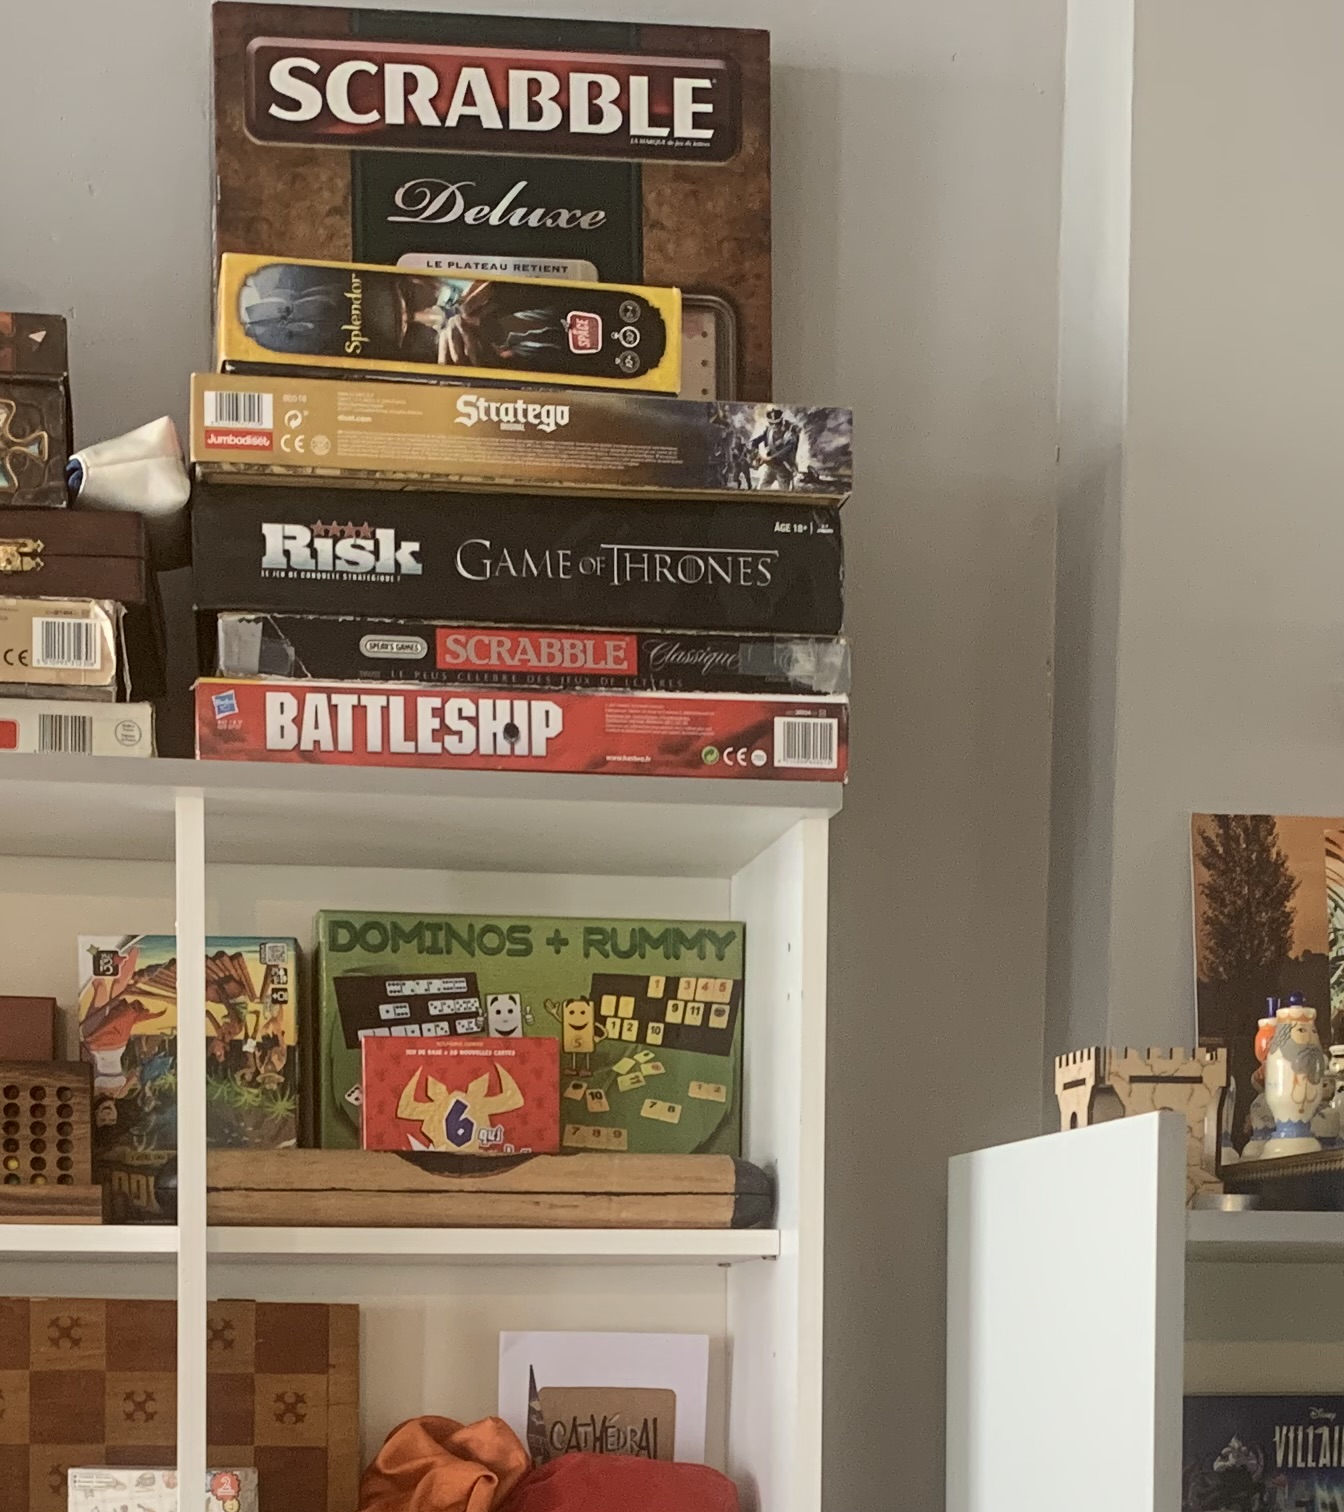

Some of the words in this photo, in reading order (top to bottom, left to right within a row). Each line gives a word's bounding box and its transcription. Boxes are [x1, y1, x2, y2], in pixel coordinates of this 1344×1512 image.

[267, 57, 716, 140] SCRABBLE
[387, 177, 607, 231] Deluxe
[427, 259, 444, 269] LE
[447, 260, 508, 273] PLATEAU
[513, 263, 569, 275] RETIENT
[345, 272, 364, 356] Splendor
[454, 395, 570, 434] Stratego
[262, 523, 422, 575] Risk
[456, 538, 572, 581] GAME
[579, 555, 605, 577] OF
[600, 544, 779, 587] THRONES
[445, 635, 629, 671] SCRABBLE
[642, 639, 741, 675] Classique
[265, 693, 564, 757] BATTLESHIP
[328, 920, 534, 958] DOMINOS
[546, 928, 570, 955] +
[582, 926, 737, 963] RUMMY
[446, 1098, 475, 1147] 6
[479, 1127, 503, 1145] qui
